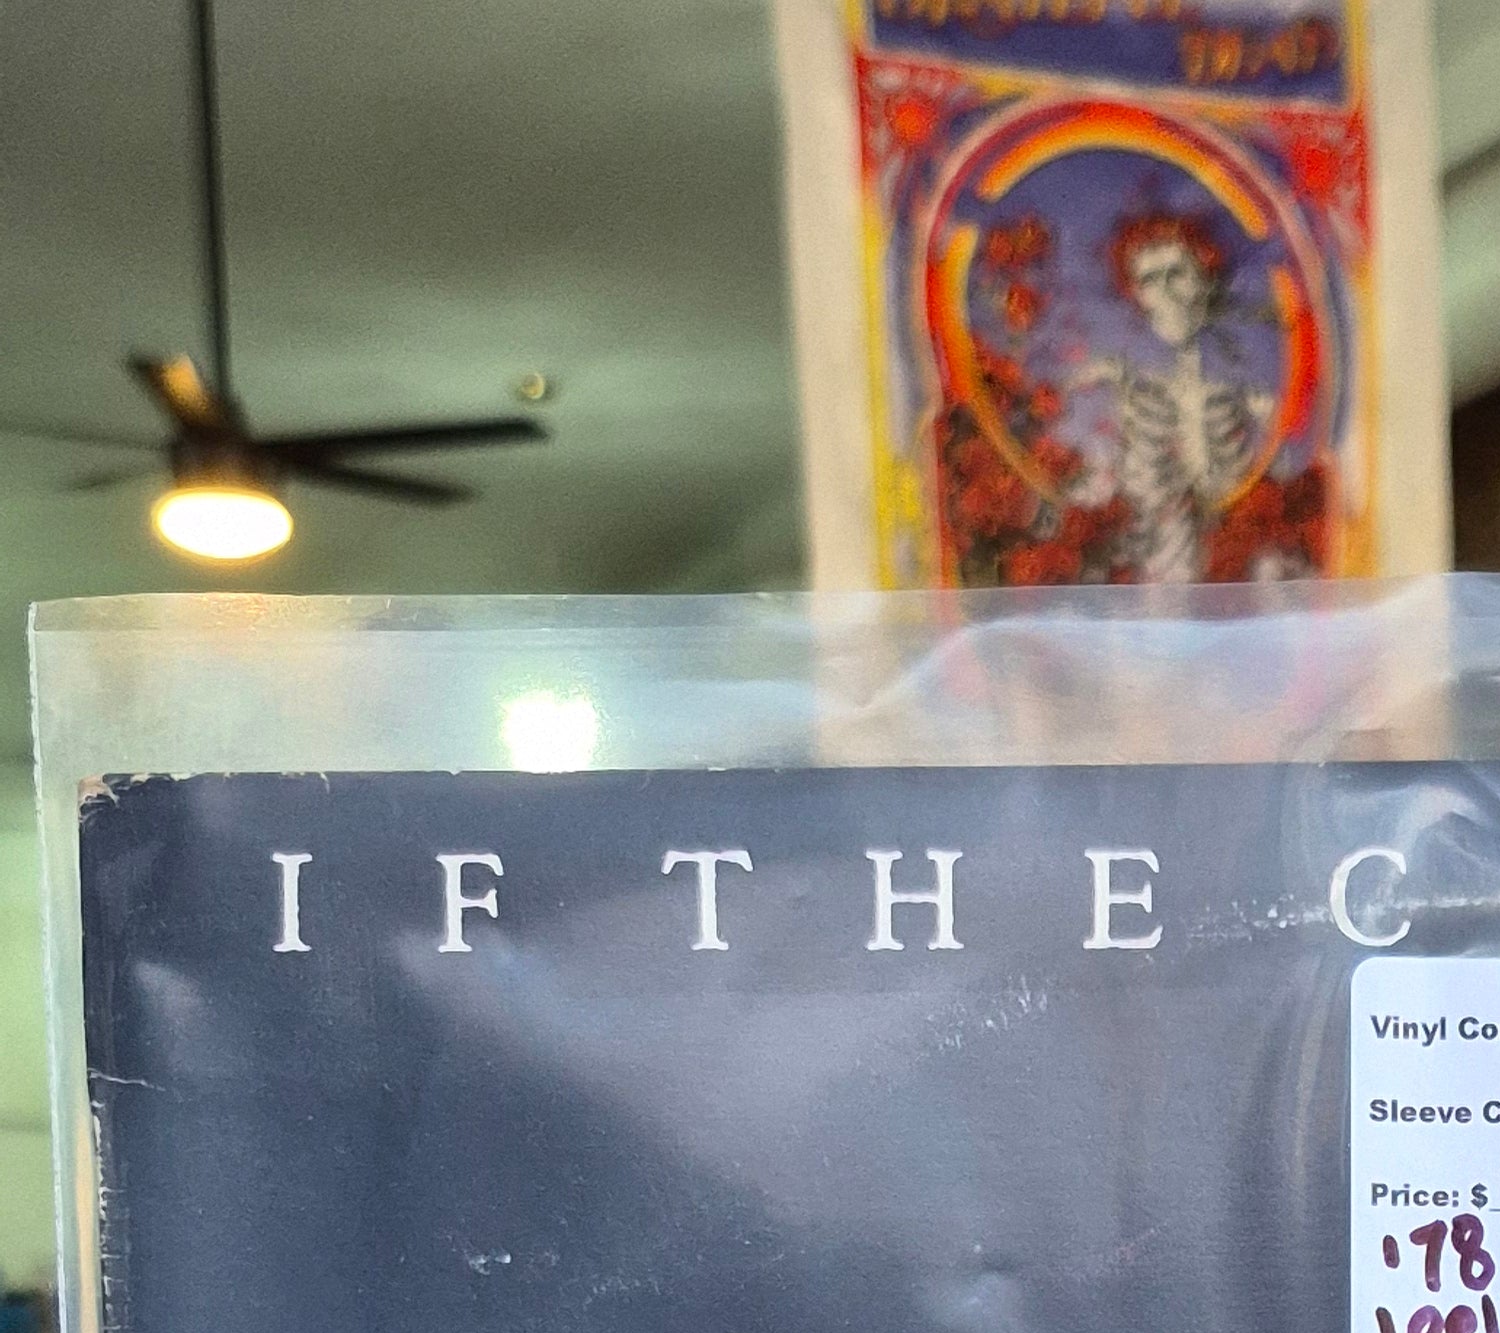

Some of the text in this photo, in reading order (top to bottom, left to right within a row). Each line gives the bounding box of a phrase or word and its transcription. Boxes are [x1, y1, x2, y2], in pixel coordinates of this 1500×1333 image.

[272, 851, 504, 952] IF
[661, 849, 1163, 951] THE
[1370, 1016, 1447, 1045] Vinyl
[1368, 1100, 1472, 1125] Sleeve
[1370, 1183, 1461, 1208] Price:
[1470, 1181, 1488, 1211] $
